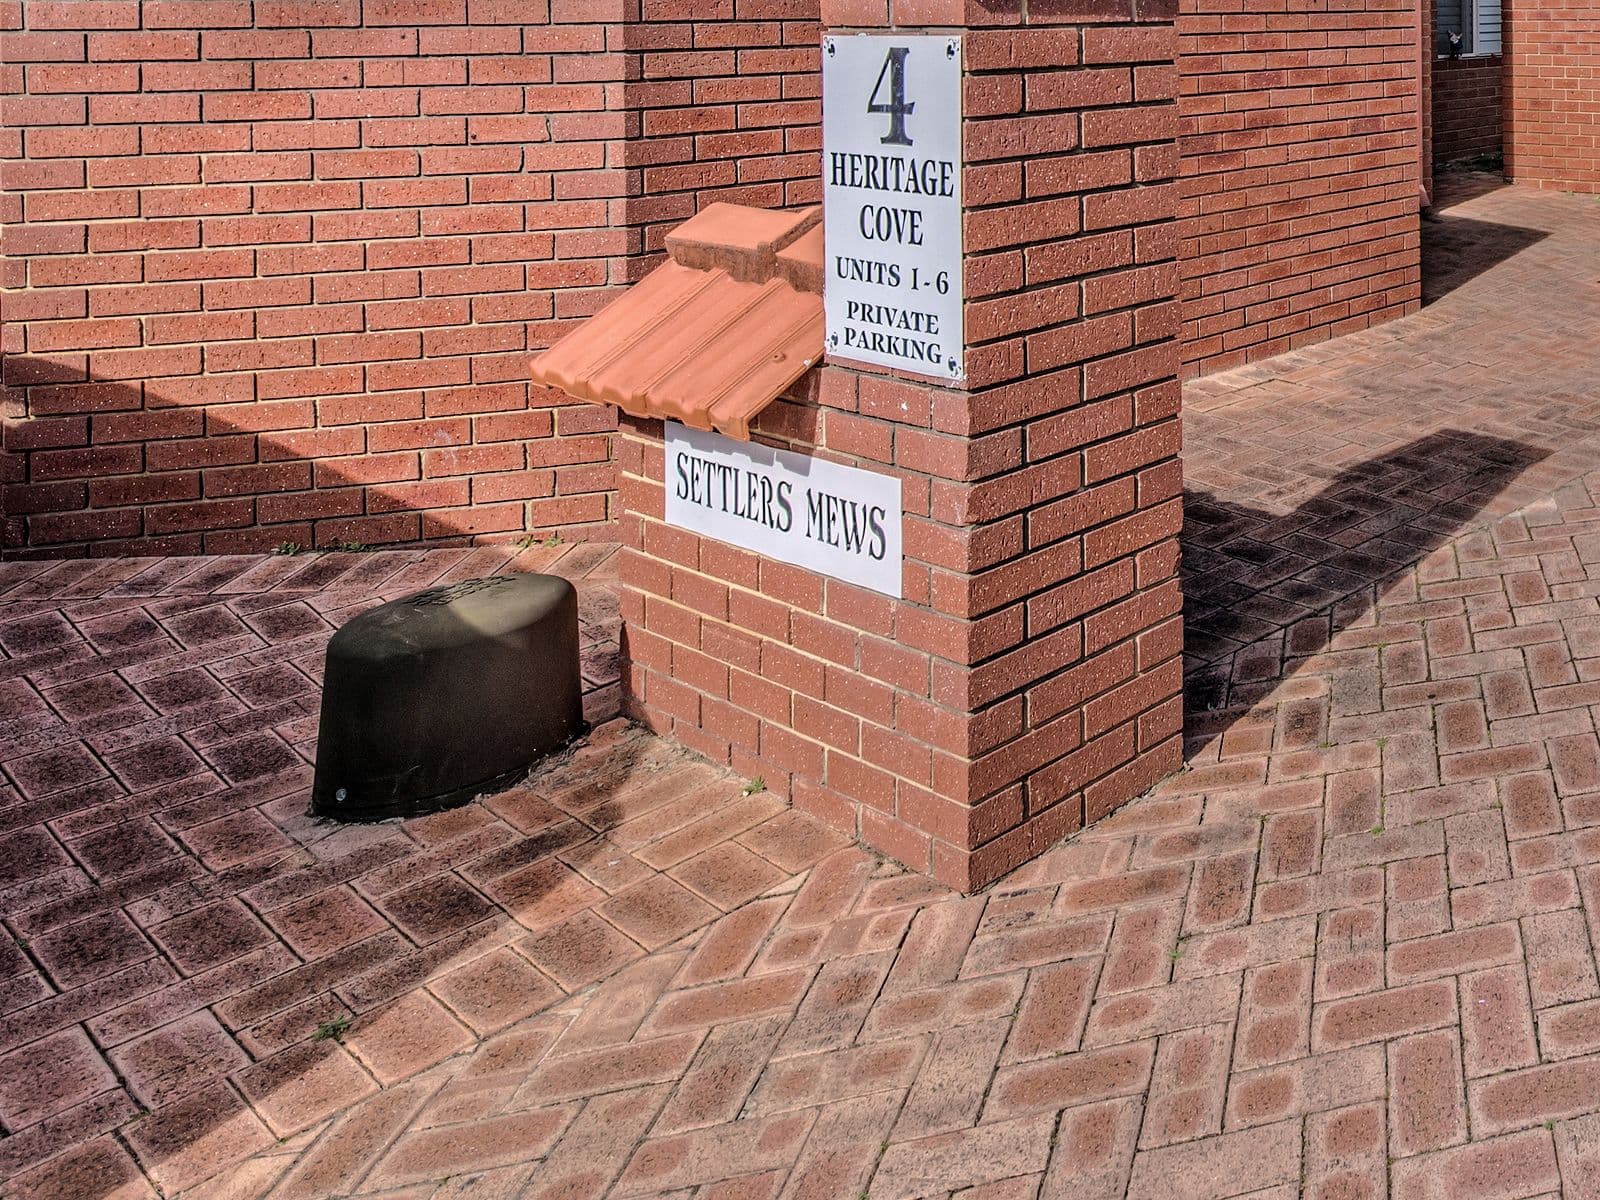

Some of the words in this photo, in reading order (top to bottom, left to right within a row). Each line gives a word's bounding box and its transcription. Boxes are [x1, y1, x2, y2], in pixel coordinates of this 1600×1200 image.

[867, 47, 915, 146] 4
[830, 152, 954, 197] HERITAGE
[860, 204, 924, 246] COVE
[836, 256, 900, 287] UNITS
[847, 300, 939, 335] PRIVATE
[844, 326, 942, 364] PARKING
[676, 452, 793, 533] SETTLERS
[806, 487, 886, 561] MEWS
